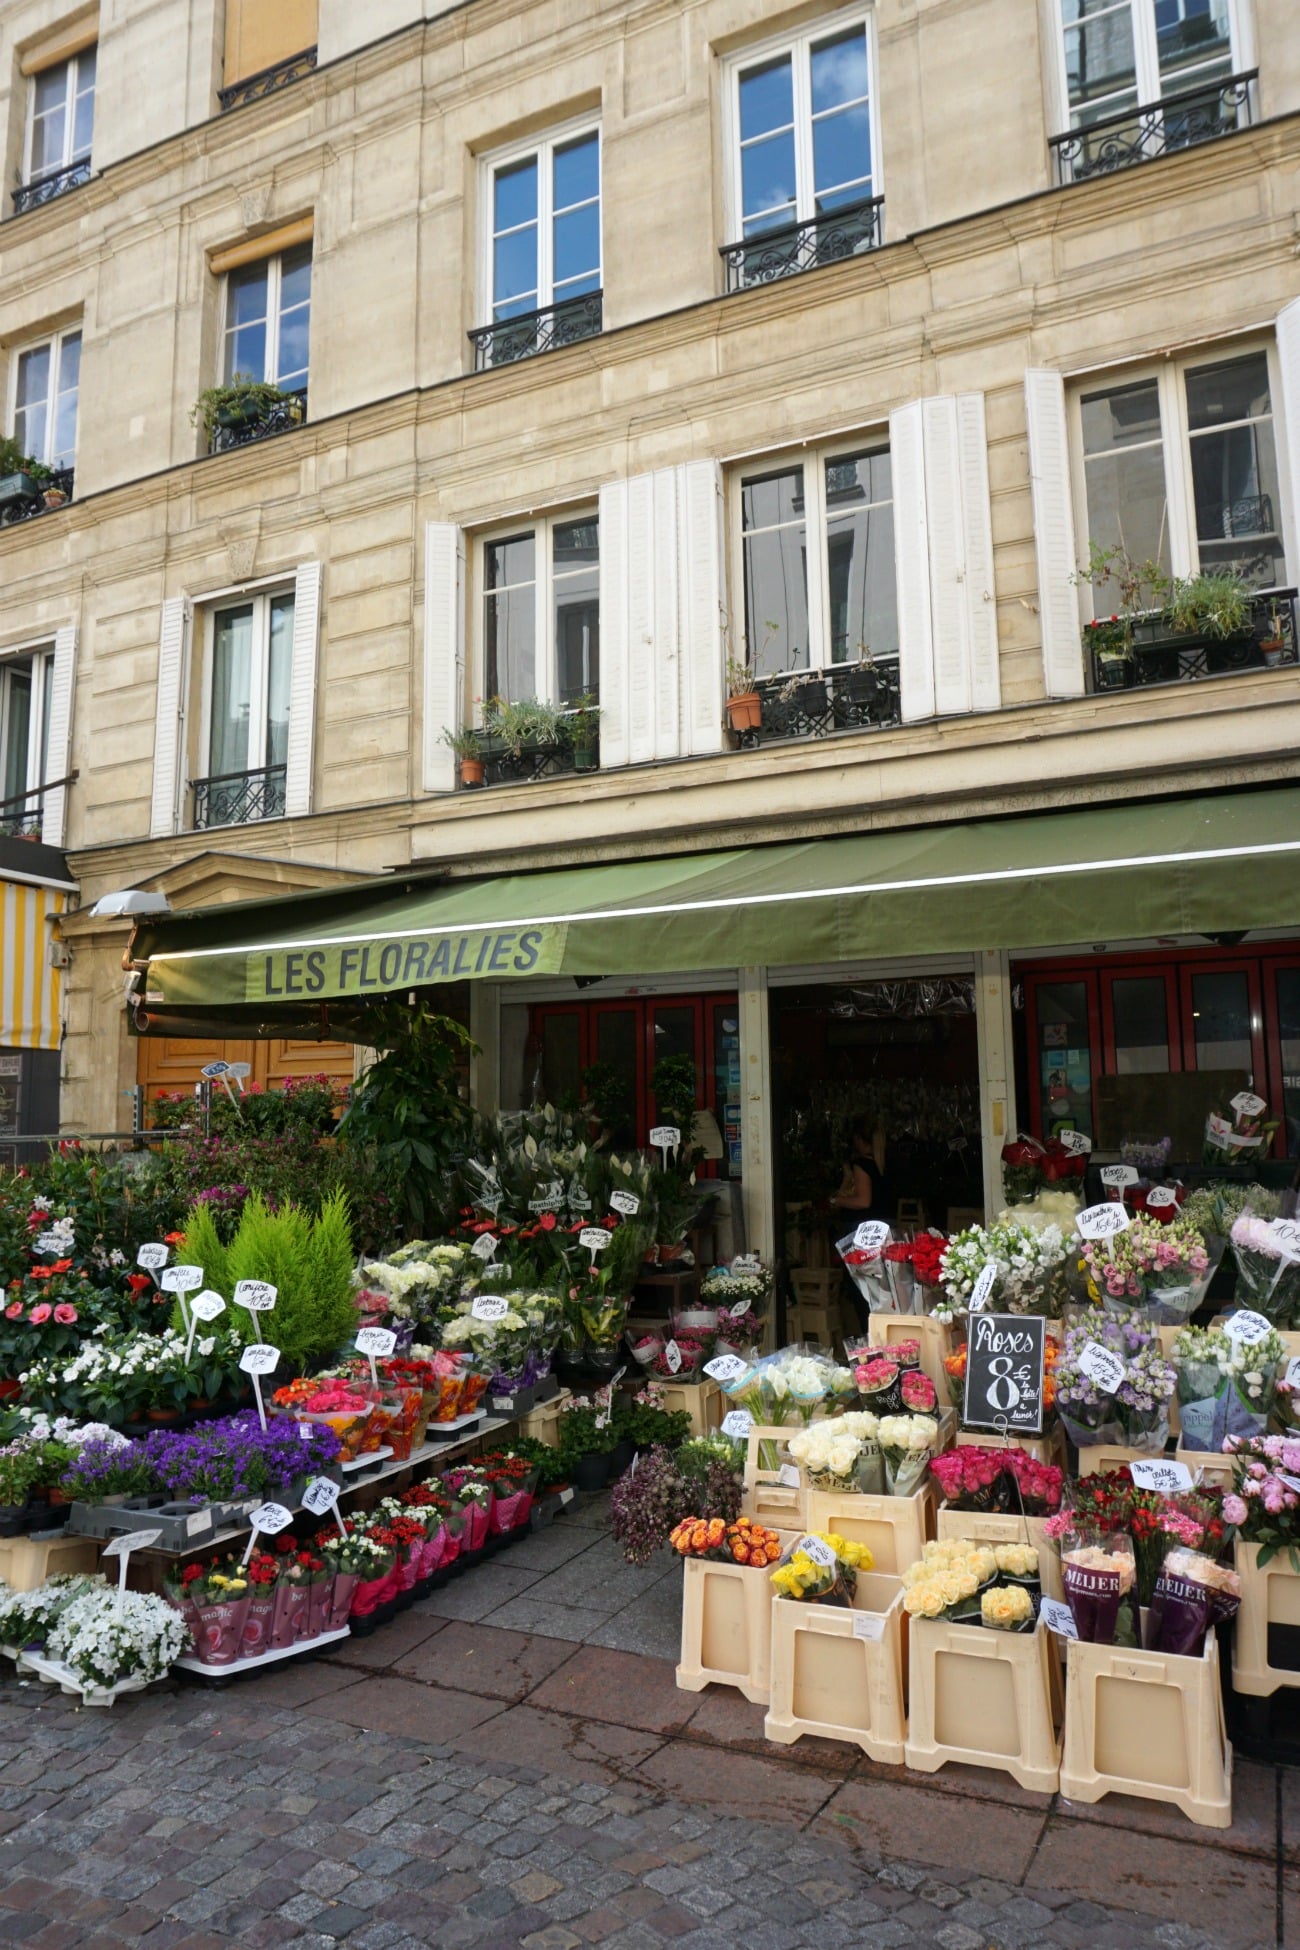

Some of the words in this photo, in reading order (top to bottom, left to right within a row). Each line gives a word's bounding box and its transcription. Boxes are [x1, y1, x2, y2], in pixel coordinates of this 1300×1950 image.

[265, 951, 326, 995] LES
[339, 931, 543, 989] FLORALIES
[976, 1316, 1034, 1355] Roses
[1064, 1568, 1121, 1591] MEIJER
[1166, 1578, 1207, 1602] EIJER
[200, 1607, 235, 1622] magic
